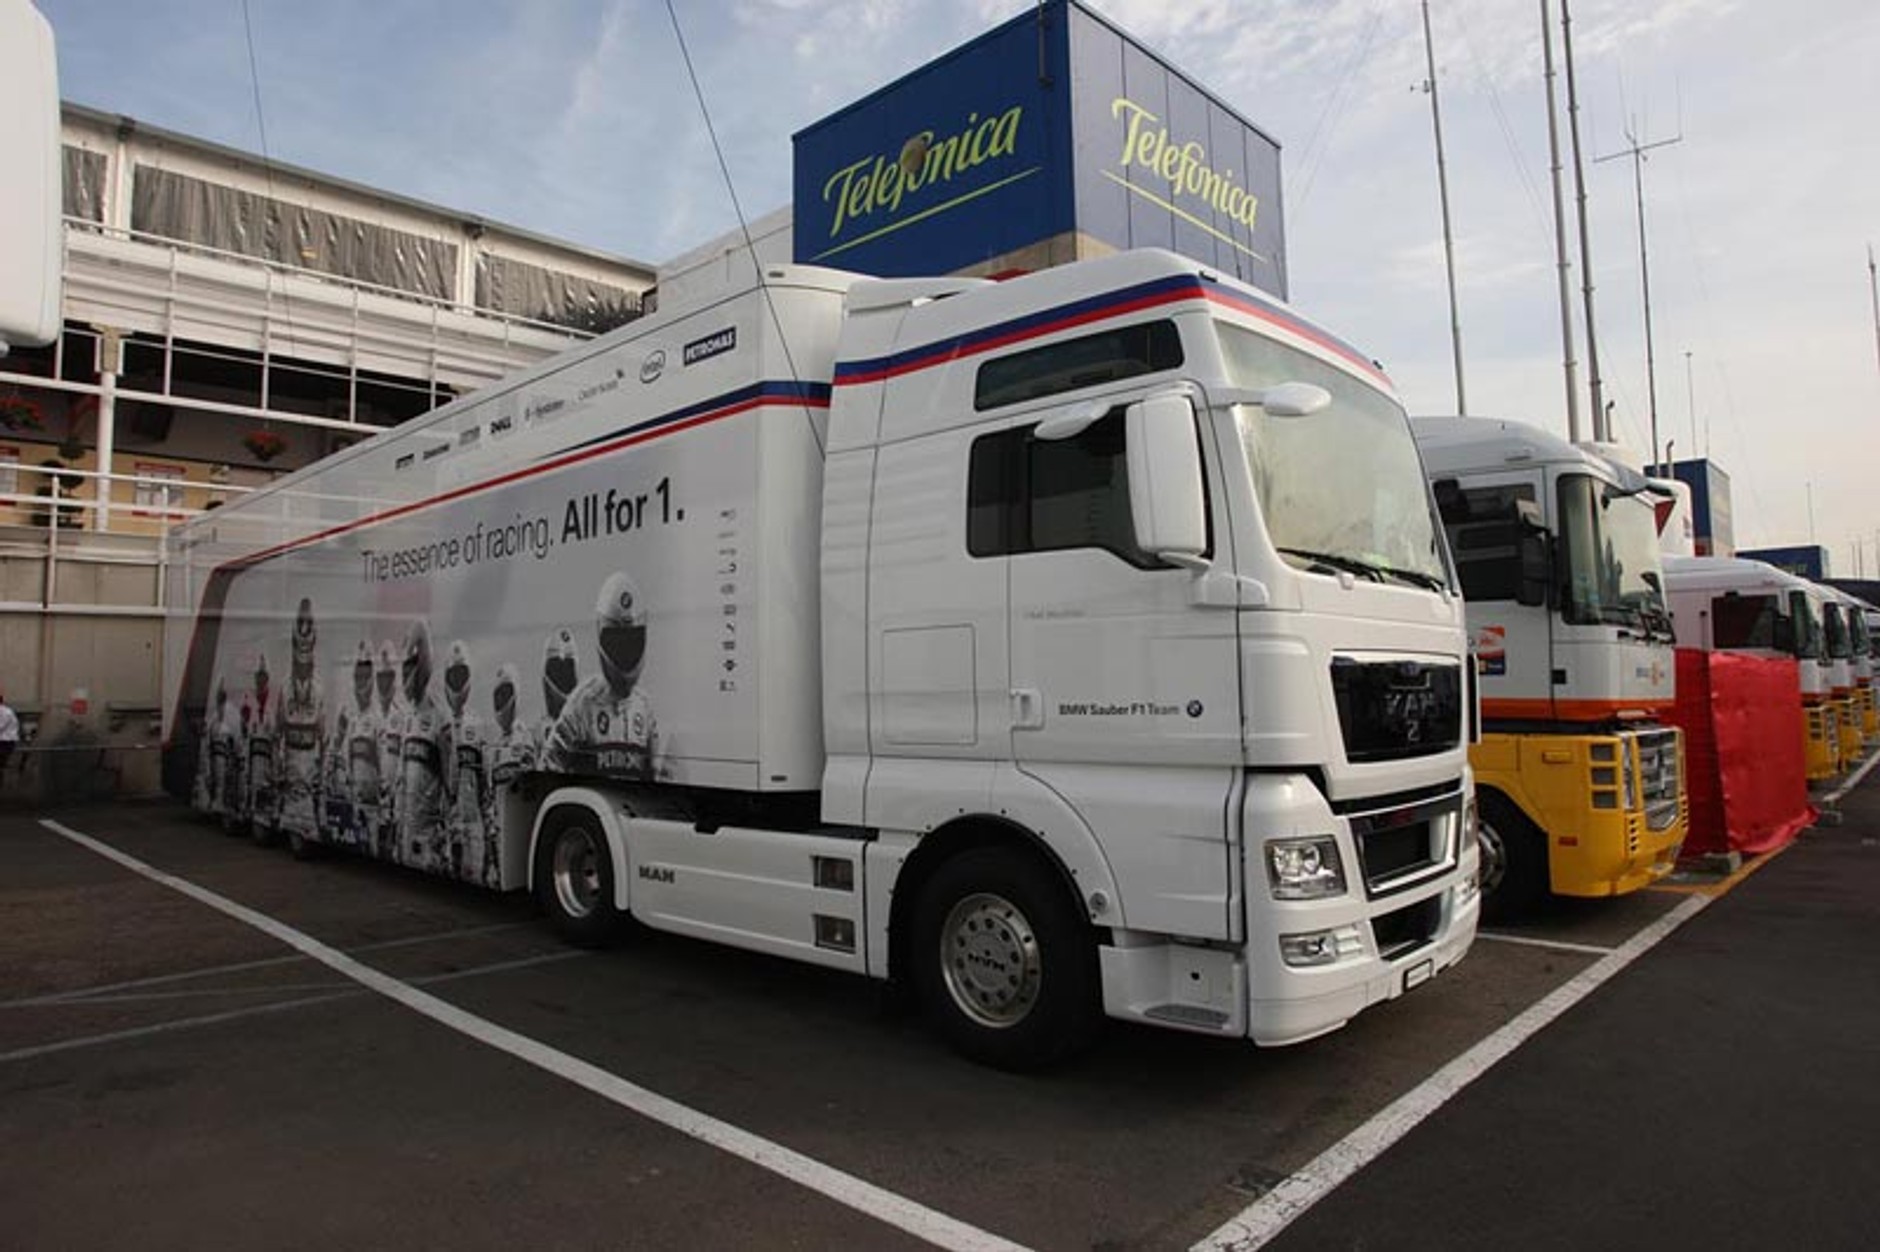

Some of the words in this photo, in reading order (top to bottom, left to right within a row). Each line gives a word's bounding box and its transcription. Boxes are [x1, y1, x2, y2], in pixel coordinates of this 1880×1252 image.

[361, 549, 389, 583] The
[392, 538, 460, 578] essence
[463, 522, 483, 564] of
[486, 513, 554, 560] racing.
[561, 493, 598, 543] All
[604, 488, 648, 535] for
[655, 476, 685, 524] 1.
[1058, 703, 1089, 716] BMW
[1090, 703, 1129, 716] Sauber
[1131, 703, 1146, 715] F1
[1148, 703, 1180, 716] Team
